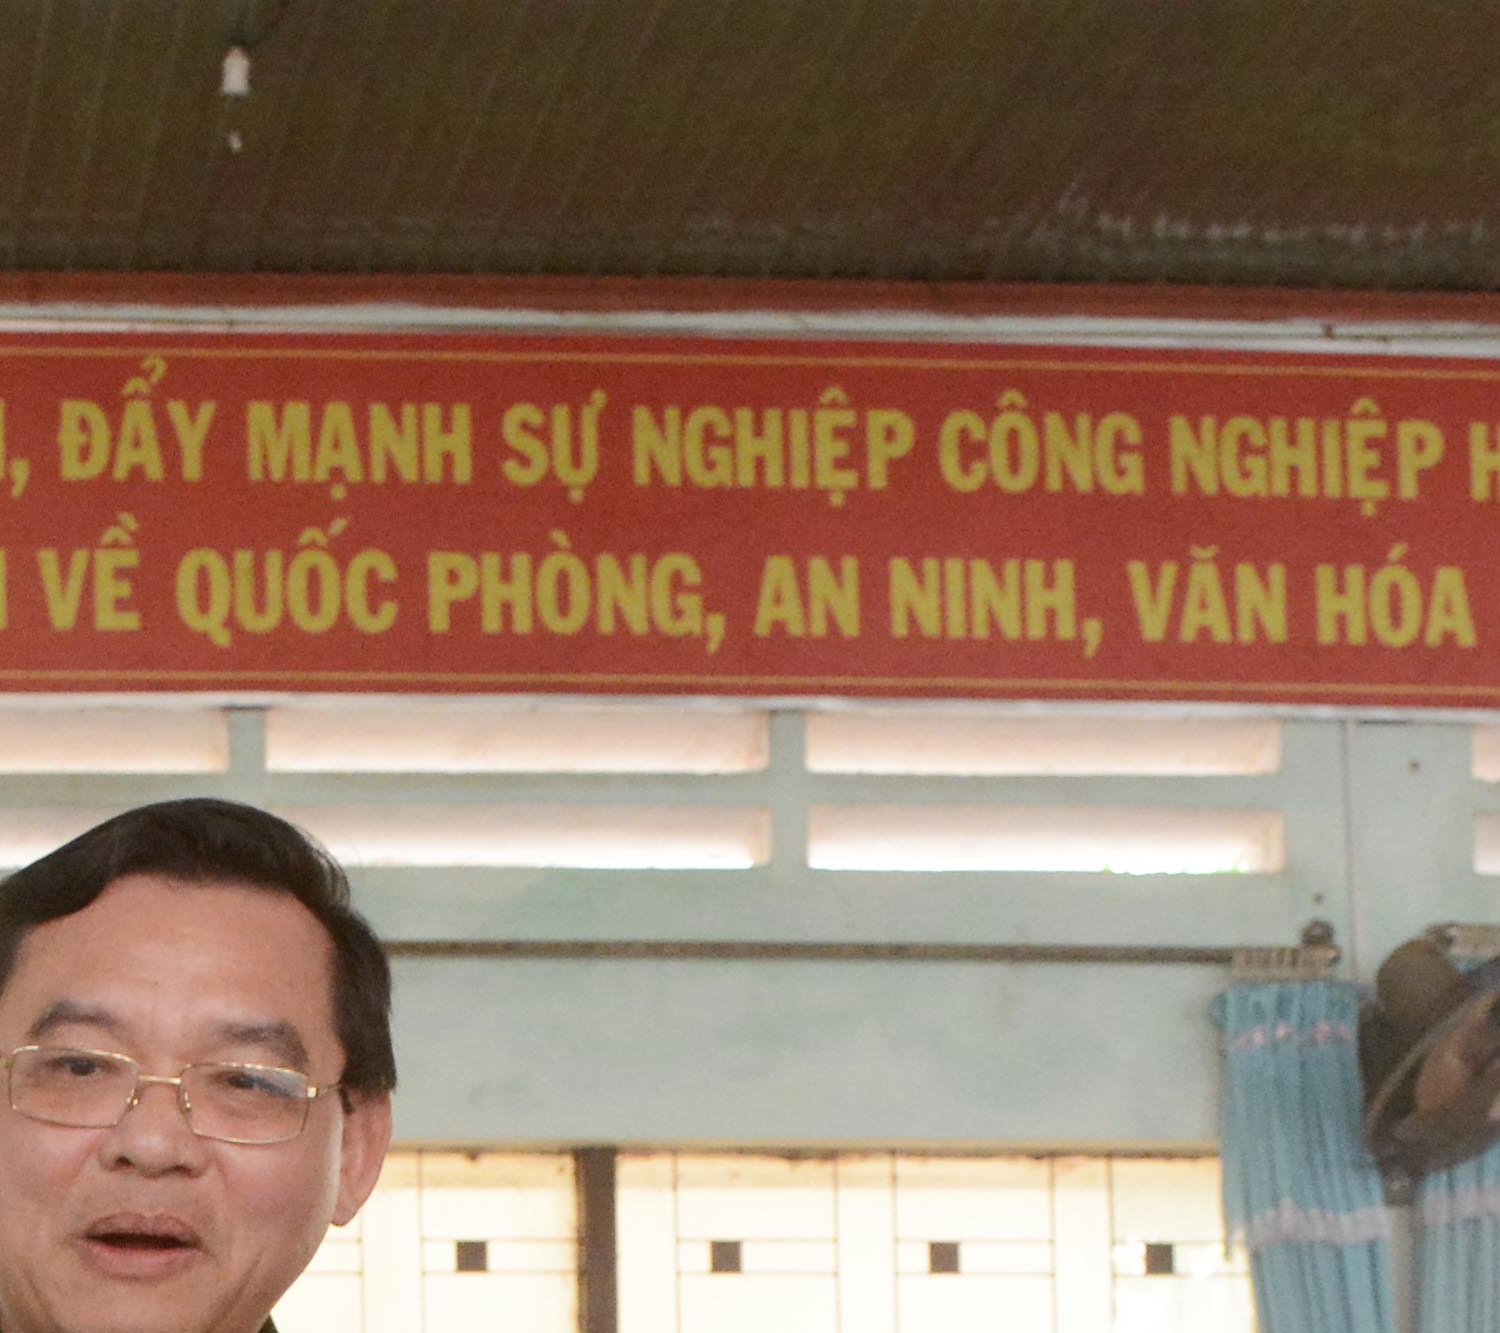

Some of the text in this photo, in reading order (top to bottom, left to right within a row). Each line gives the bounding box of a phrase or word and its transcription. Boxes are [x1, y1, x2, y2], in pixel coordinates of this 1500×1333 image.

[55, 358, 217, 483] ĐẨY
[246, 399, 473, 501] MẠNH
[501, 389, 607, 504] SỰ
[632, 386, 916, 507] NGHIỆP
[937, 388, 1146, 497] CÔNG
[1168, 396, 1446, 516] NGHIỆP
[35, 511, 143, 634] VỀ
[173, 516, 400, 650] QUỐC
[426, 528, 727, 656] PHÒNG,
[752, 553, 863, 640] AN
[887, 555, 1105, 659] NINH,
[1126, 544, 1290, 646] VĂN
[1314, 542, 1479, 650] HÓA
